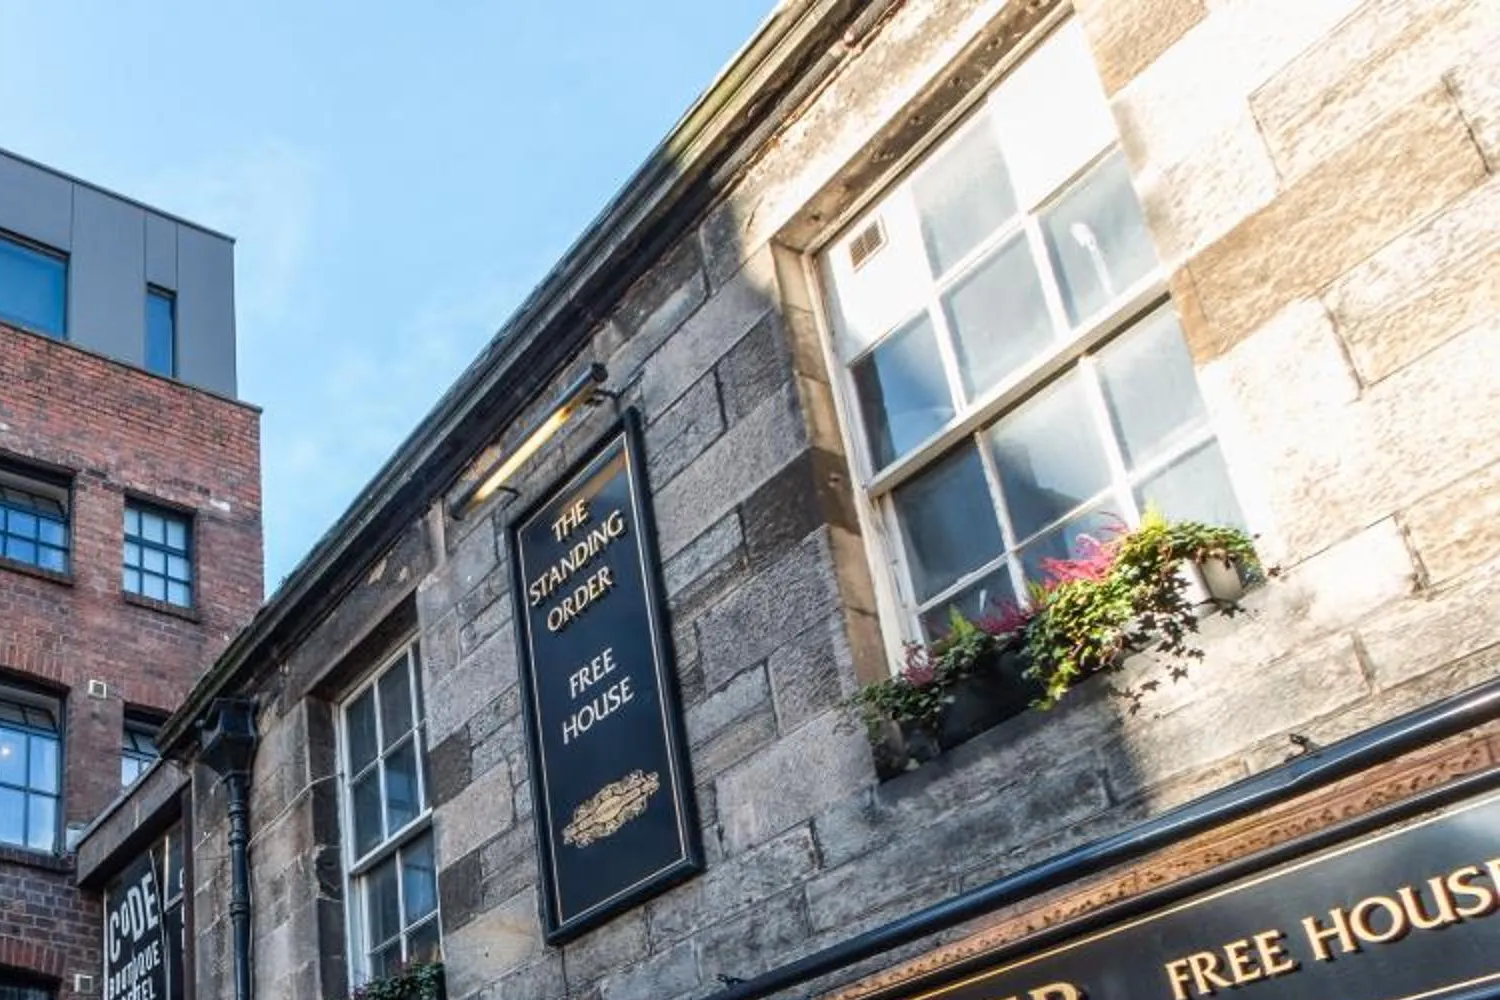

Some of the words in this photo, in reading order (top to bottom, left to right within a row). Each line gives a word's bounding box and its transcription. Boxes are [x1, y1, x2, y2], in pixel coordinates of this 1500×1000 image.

[552, 499, 588, 541] THE
[529, 509, 624, 607] STANDING
[547, 566, 613, 631] ORDER
[569, 647, 617, 700] FREE
[562, 676, 635, 745] HOUSE
